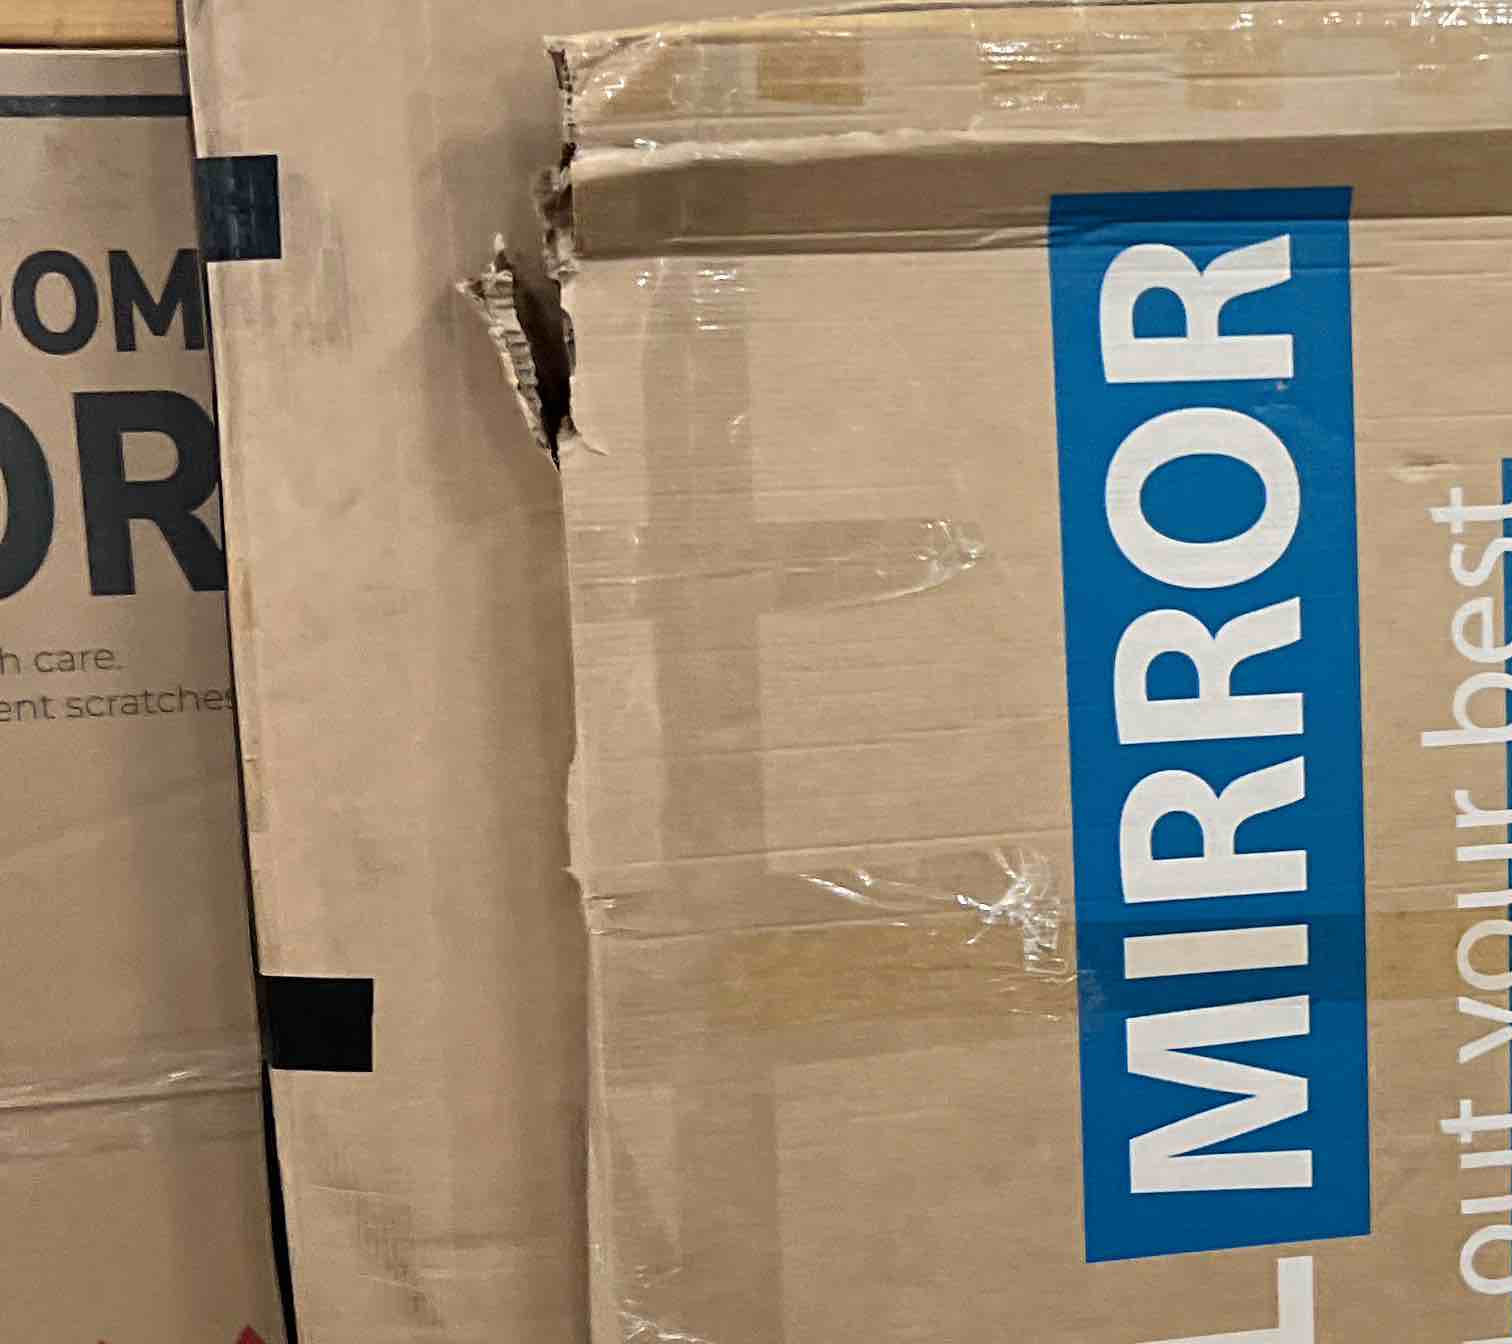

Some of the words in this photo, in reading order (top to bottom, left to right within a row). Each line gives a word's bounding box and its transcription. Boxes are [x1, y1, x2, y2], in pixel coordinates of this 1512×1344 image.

[0, 247, 206, 357] OM
[34, 646, 126, 674] care.
[1098, 232, 1314, 1195] MIRROR
